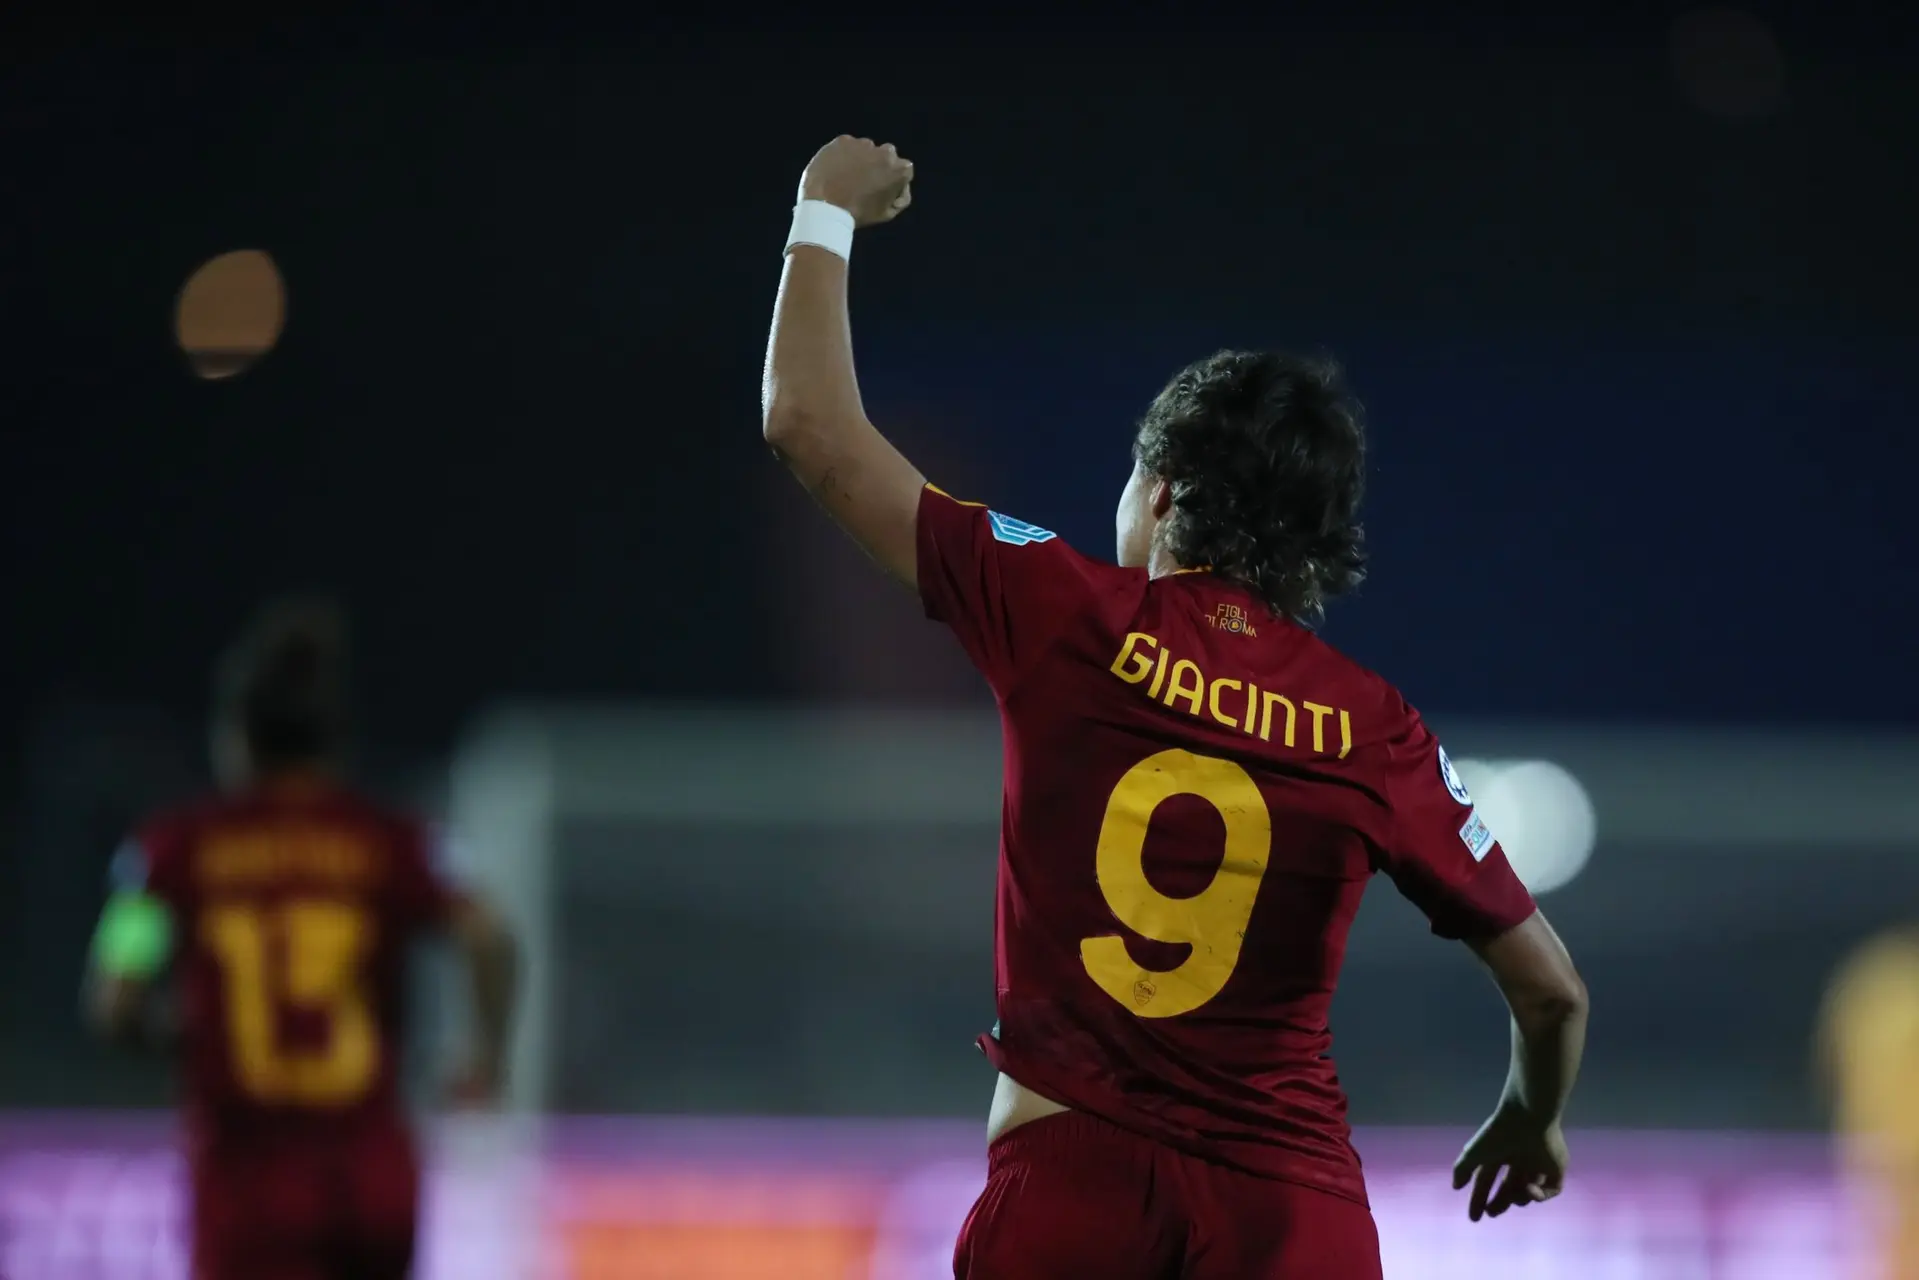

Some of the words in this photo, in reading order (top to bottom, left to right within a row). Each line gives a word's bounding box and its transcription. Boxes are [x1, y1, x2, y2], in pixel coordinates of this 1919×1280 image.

[1217, 603, 1248, 622] FIGLI
[1110, 632, 1352, 760] GIACINTI
[1080, 748, 1271, 1018] 9
